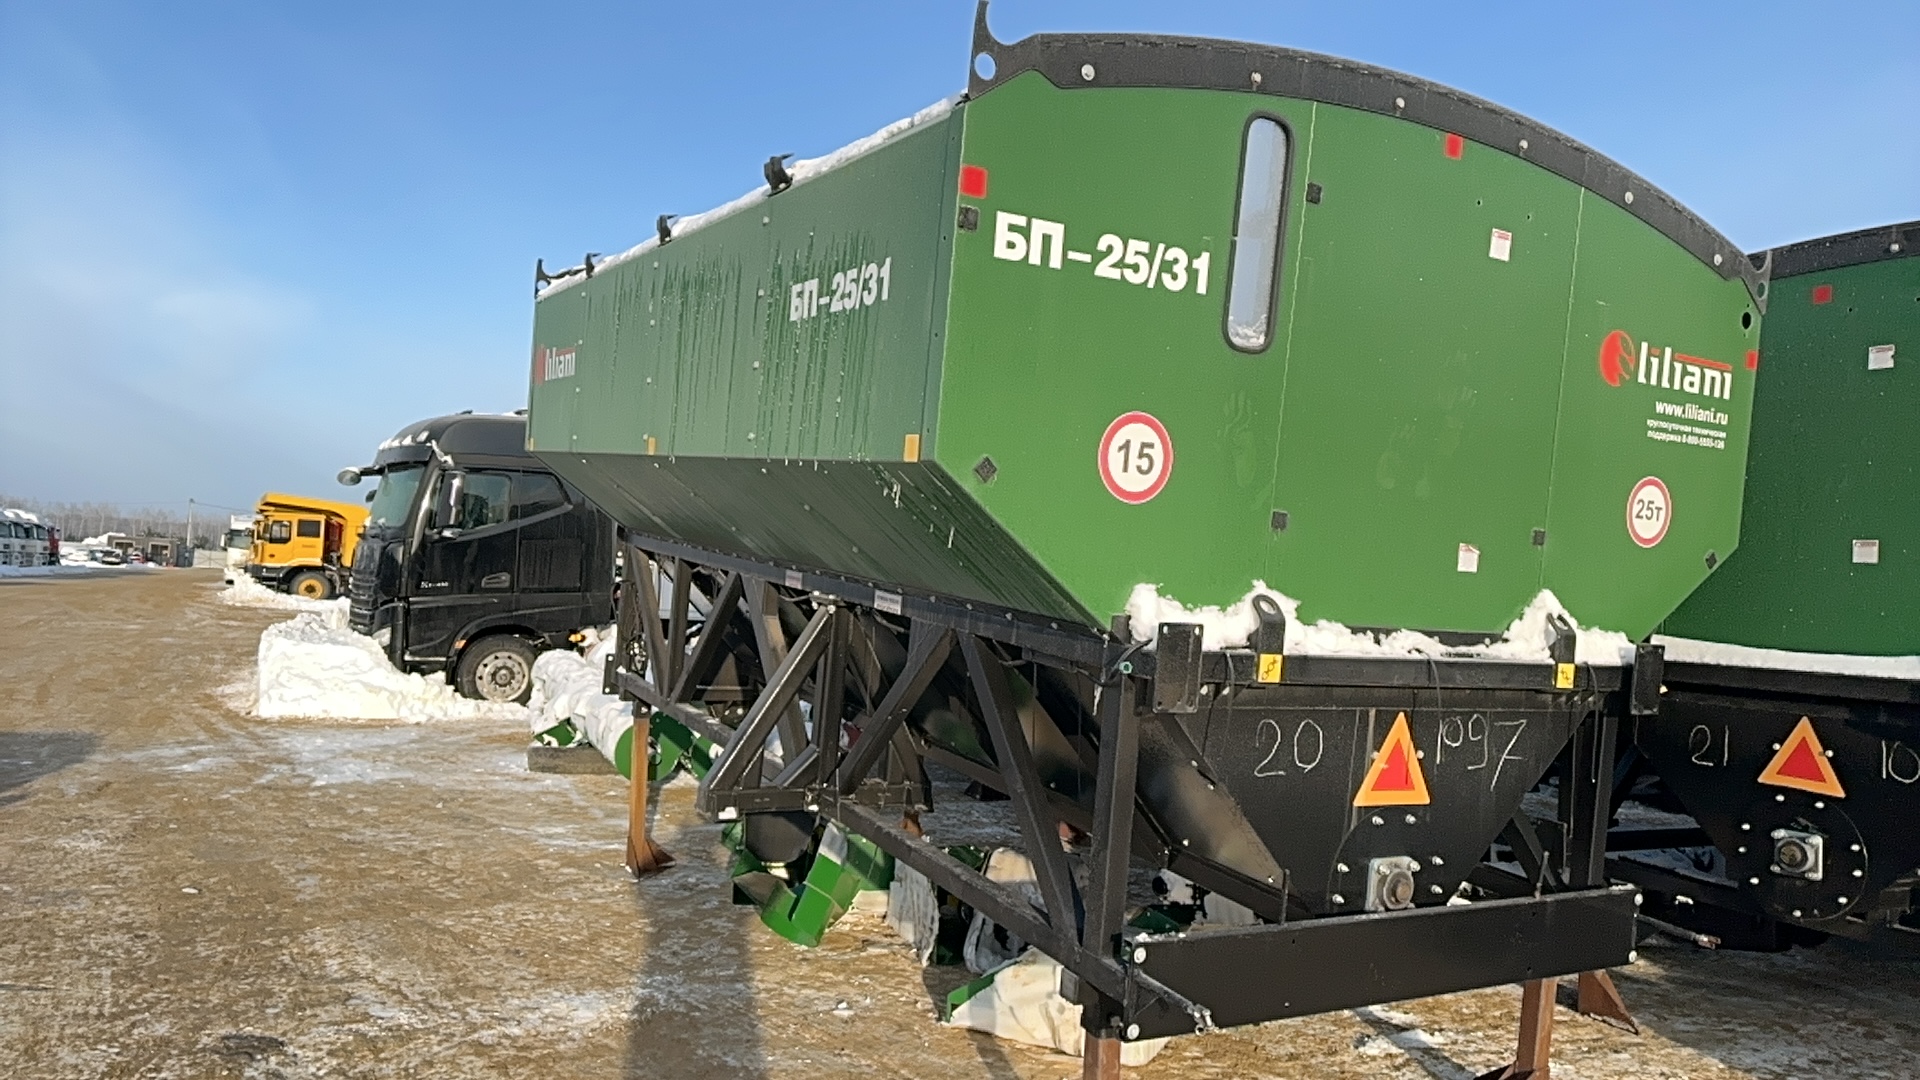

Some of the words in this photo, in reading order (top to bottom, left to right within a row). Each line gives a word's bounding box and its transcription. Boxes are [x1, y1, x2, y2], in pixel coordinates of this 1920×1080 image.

[994, 210, 1211, 295] БП-25/31
[789, 256, 892, 322] БП-25/31
[1655, 401, 1729, 425] www.liliani.ru
[1117, 439, 1155, 476] 15
[1253, 718, 1324, 777] 20
[1435, 713, 1528, 792] 1097
[1687, 724, 1730, 767] 21
